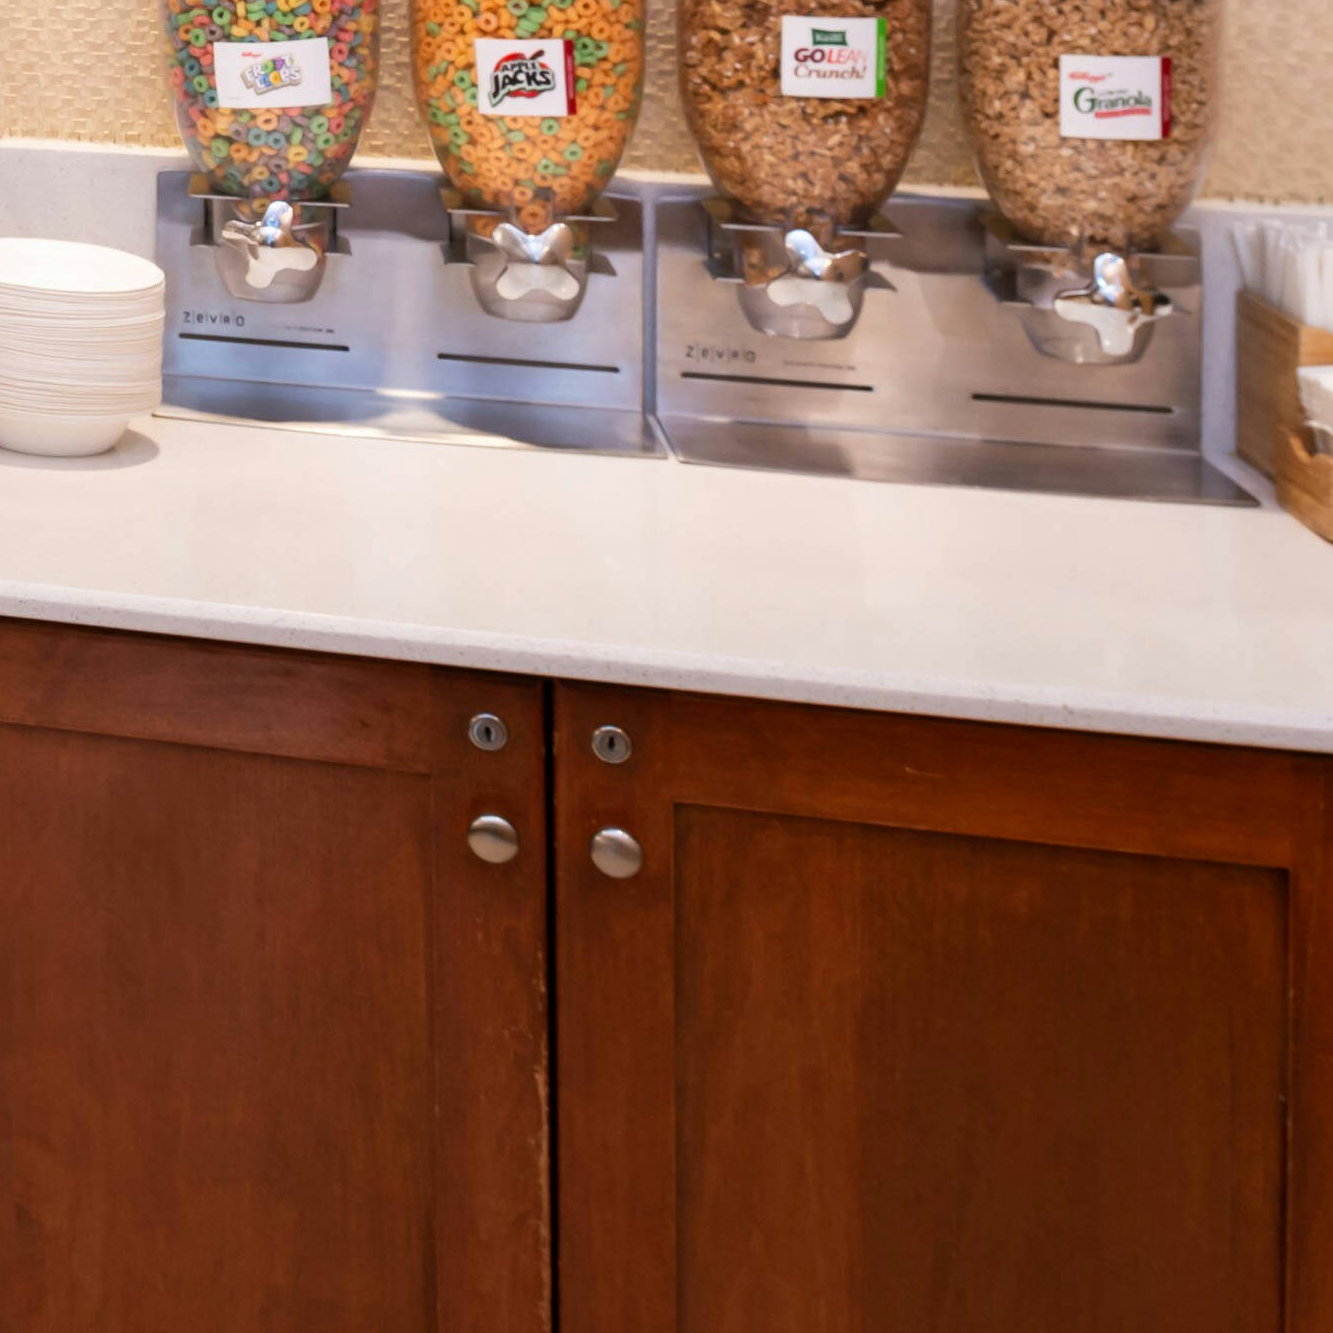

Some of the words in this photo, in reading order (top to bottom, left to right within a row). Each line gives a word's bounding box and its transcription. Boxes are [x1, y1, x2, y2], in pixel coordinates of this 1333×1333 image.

[493, 70, 551, 99] JACKS
[793, 65, 867, 79] Crunch!
[1073, 86, 1152, 114] Granola
